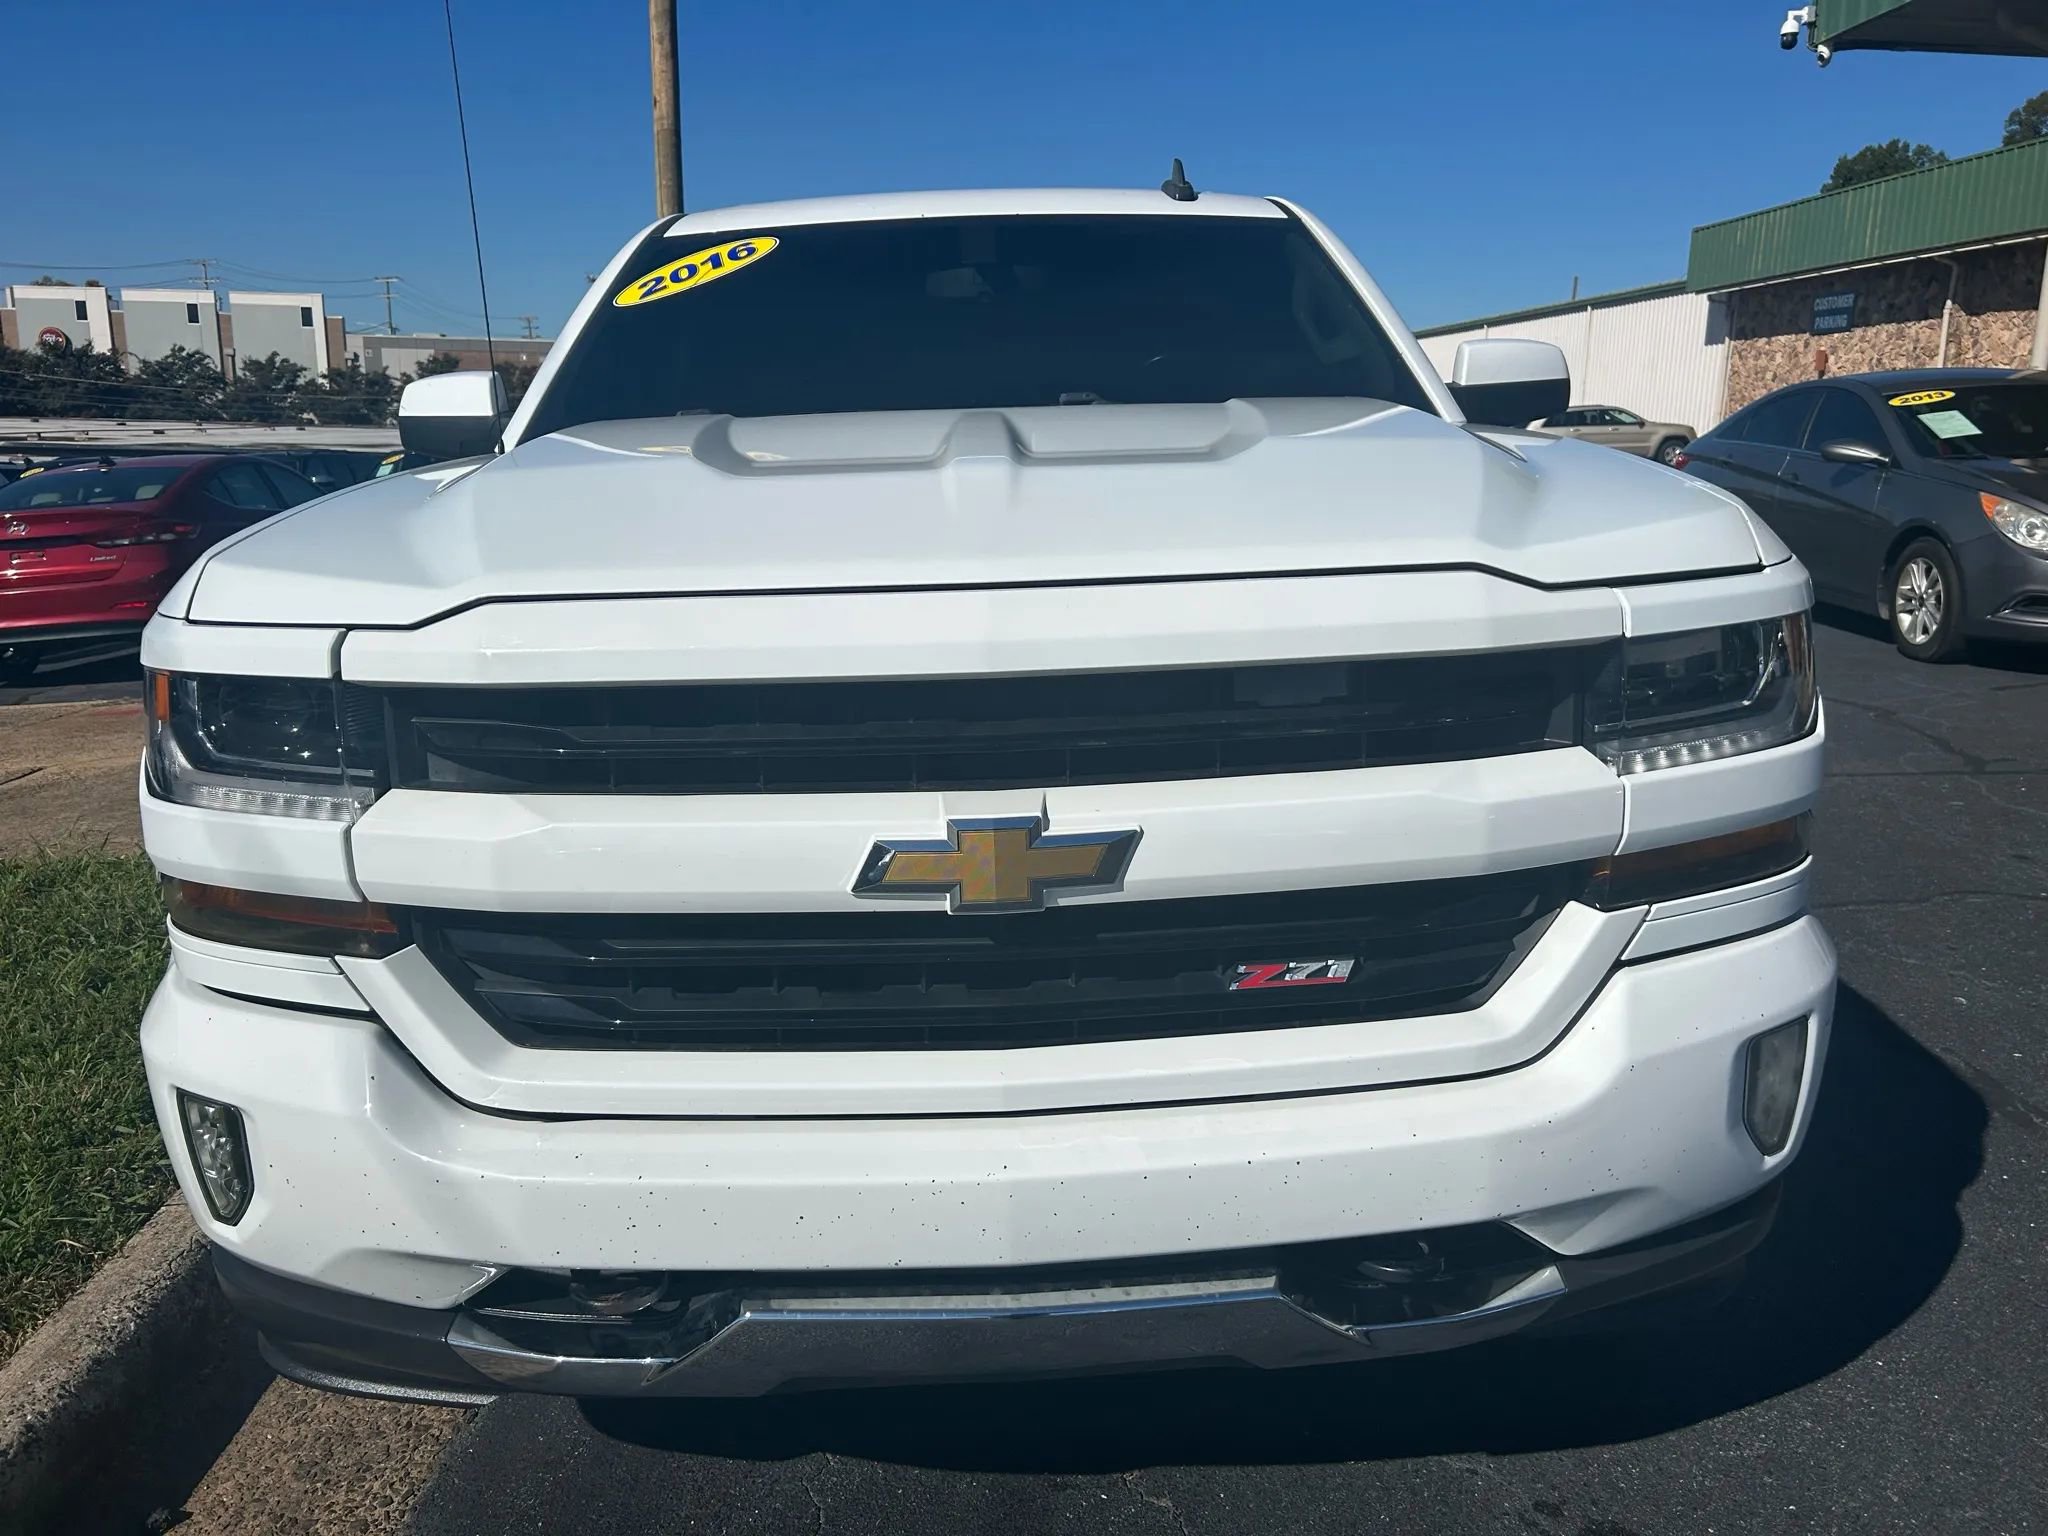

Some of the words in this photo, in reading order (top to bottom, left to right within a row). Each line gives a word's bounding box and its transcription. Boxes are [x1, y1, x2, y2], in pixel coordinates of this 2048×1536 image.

[637, 241, 758, 300] 2016
[1813, 293, 1855, 311] CUSTOMER
[1814, 314, 1848, 330] PARKING
[1898, 391, 1947, 404] 2013
[1229, 959, 1355, 990] Z71
